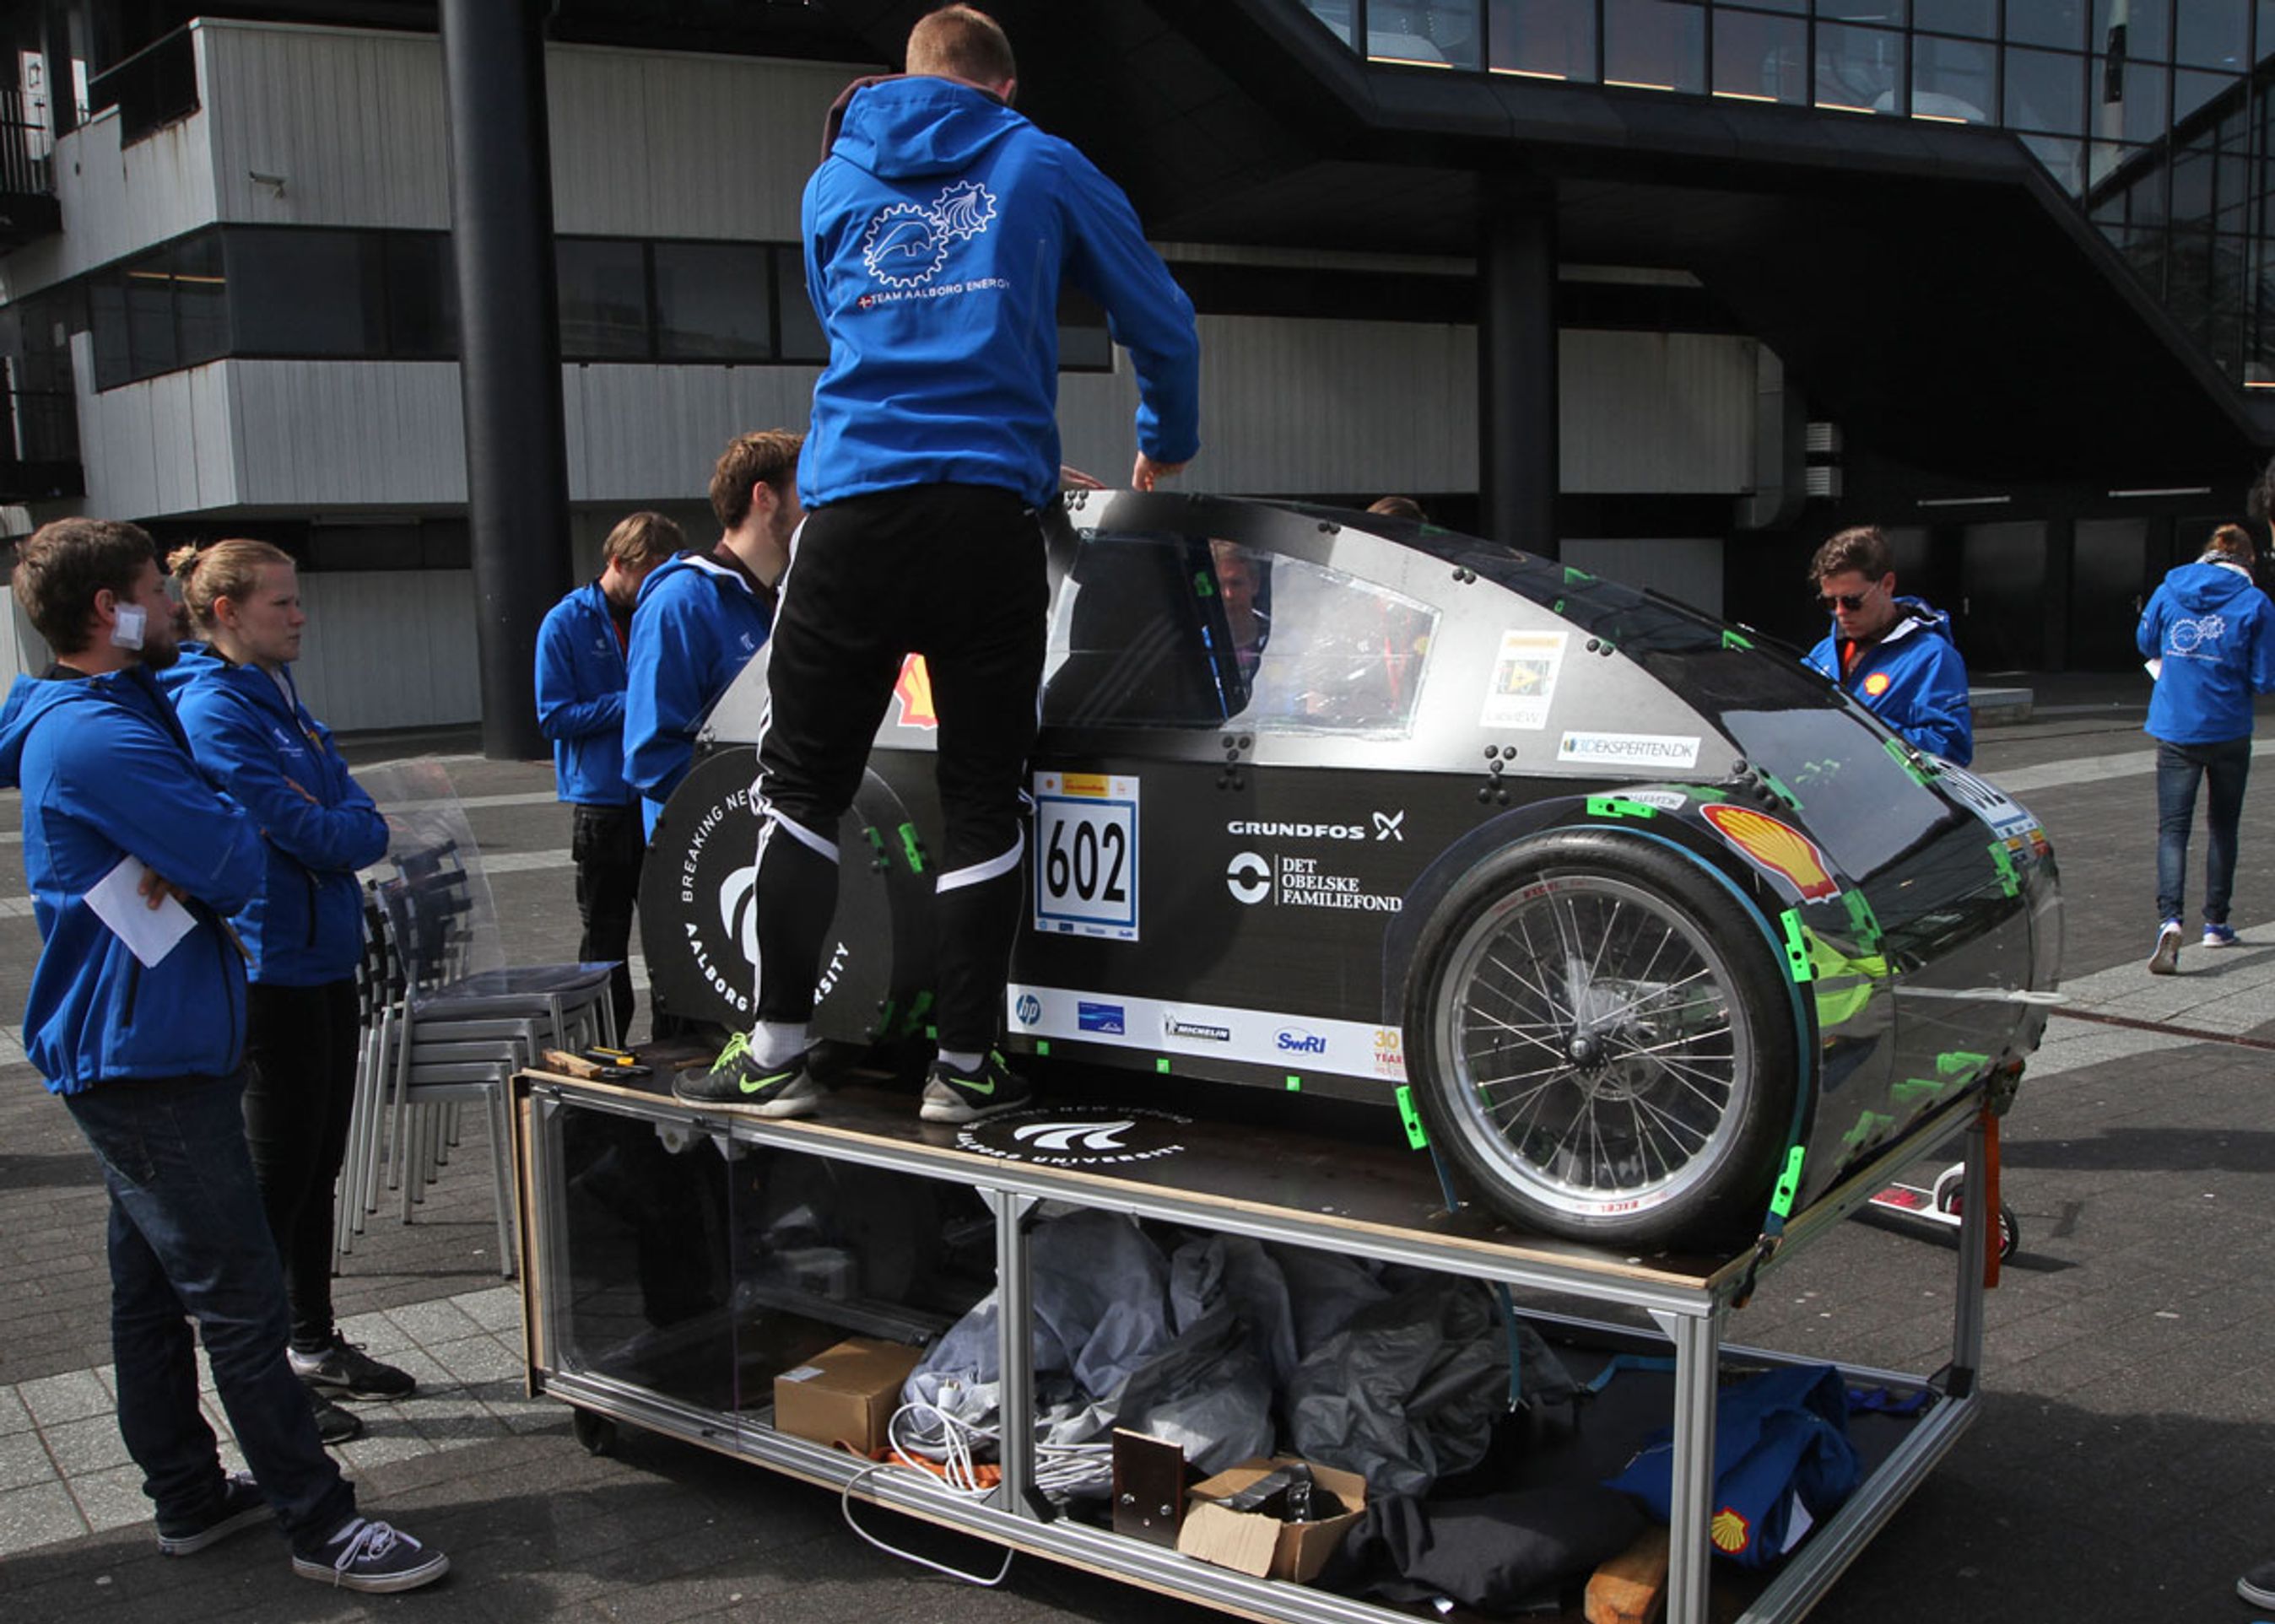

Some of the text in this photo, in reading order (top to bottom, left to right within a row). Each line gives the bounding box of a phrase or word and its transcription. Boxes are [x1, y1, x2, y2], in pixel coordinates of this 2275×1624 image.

[871, 291, 902, 305] TEAM
[905, 283, 963, 300] AALBORG
[1227, 820, 1365, 841] GRUNDFOS
[682, 787, 752, 902] BREAKING NE
[1046, 819, 1126, 903] 602
[1282, 857, 1317, 874] DET
[1282, 873, 1359, 893] OBELSKE
[1282, 889, 1402, 912] FAMILIEFOND
[684, 922, 748, 1012] AALBORG
[1018, 994, 1040, 1025] hp
[1177, 1024, 1229, 1039] MICHELIN
[1375, 1029, 1399, 1049] 30
[1277, 1033, 1327, 1054] SwRI
